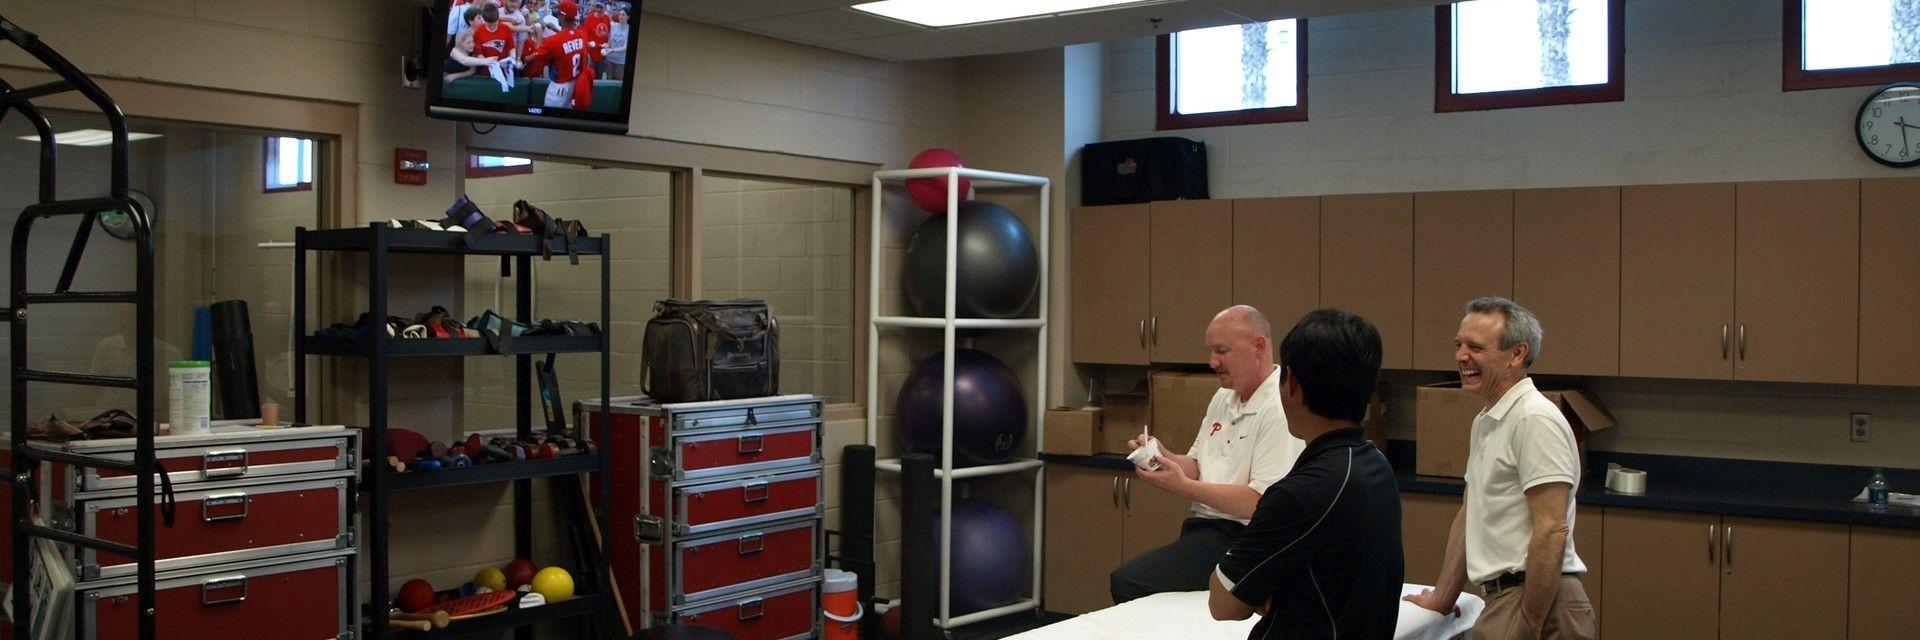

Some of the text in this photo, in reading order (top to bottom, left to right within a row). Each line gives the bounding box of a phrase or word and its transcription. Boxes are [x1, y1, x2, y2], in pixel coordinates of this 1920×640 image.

[1899, 92, 1910, 103] 12
[1873, 107, 1882, 118] 10
[1866, 121, 1873, 130] 9
[1871, 134, 1878, 145] 8
[1885, 144, 1892, 154] 7
[1899, 147, 1906, 157] 6
[1210, 422, 1222, 436] P
